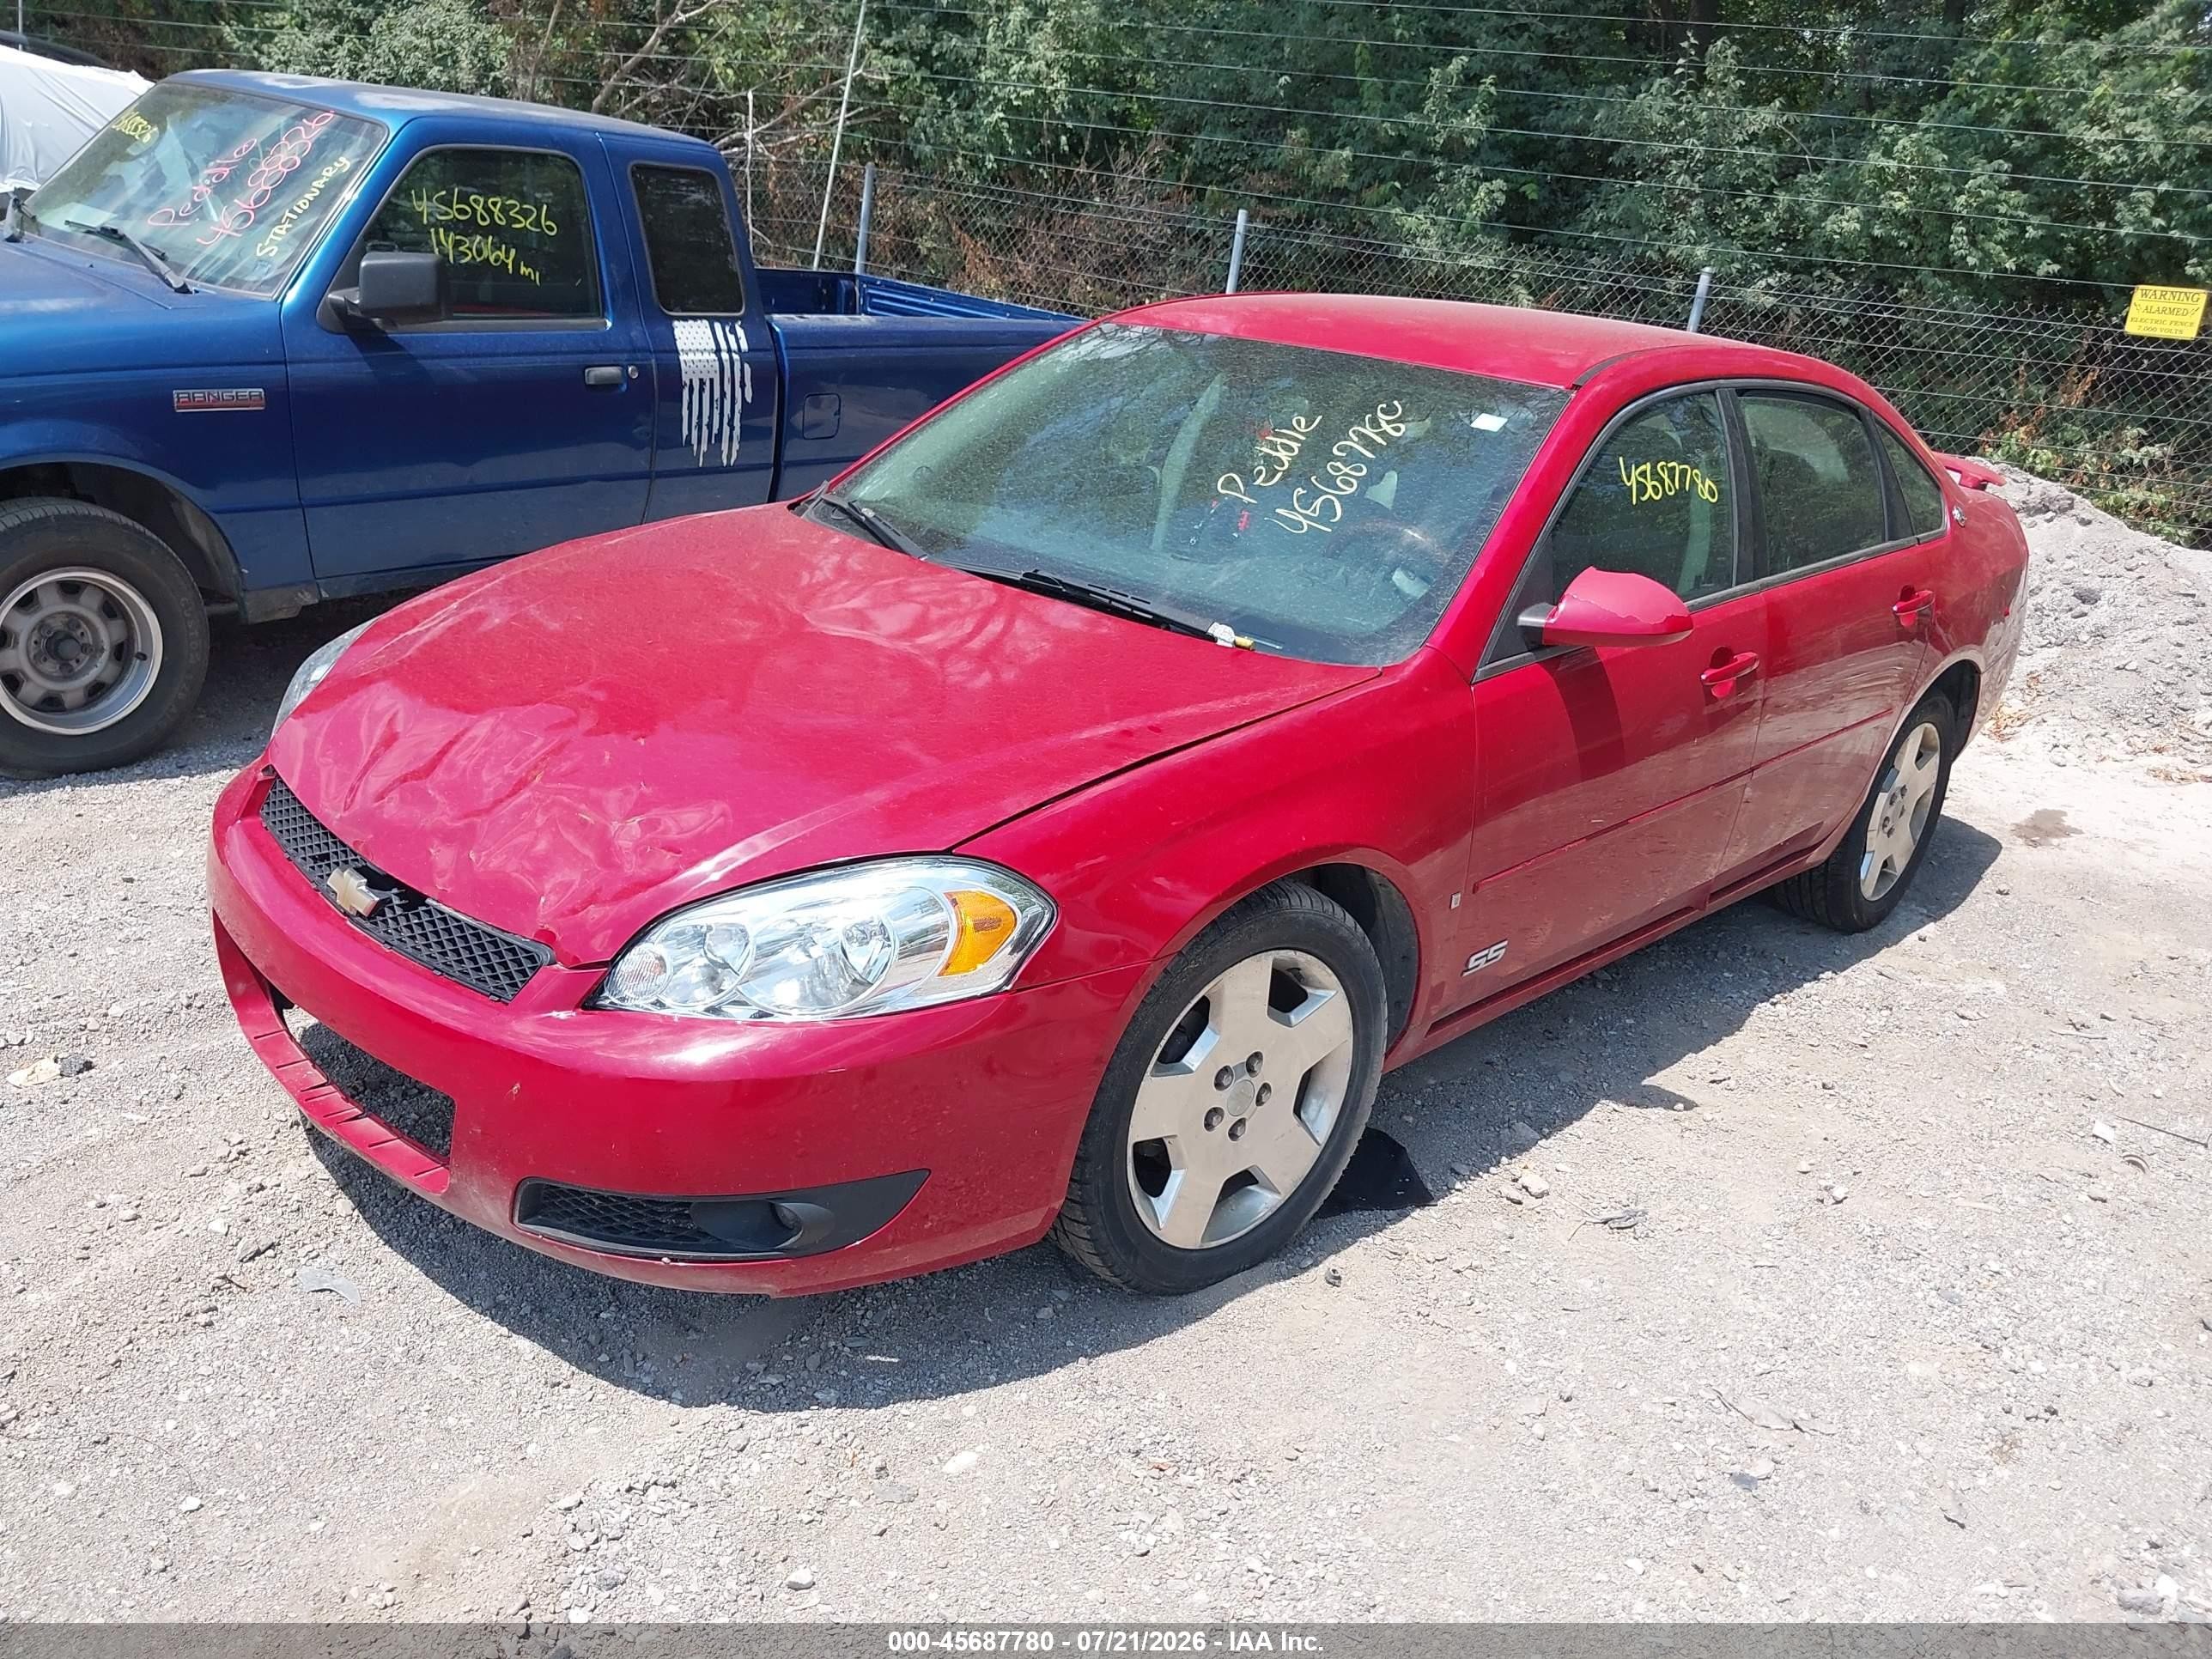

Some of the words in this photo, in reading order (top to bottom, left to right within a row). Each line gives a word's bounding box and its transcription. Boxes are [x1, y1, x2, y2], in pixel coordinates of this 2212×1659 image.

[196, 111, 334, 245] 45688326
[256, 156, 350, 257] STATIONARY
[411, 187, 557, 236] 45688326
[430, 227, 516, 274] 143064
[2141, 289, 2200, 302] WARNING
[2142, 305, 2189, 316] ALARMED
[2130, 317, 2167, 325] ELECTRIC
[173, 389, 264, 411] RANGER
[1619, 456, 1718, 506] 45687780
[1462, 939, 1509, 977] SS
